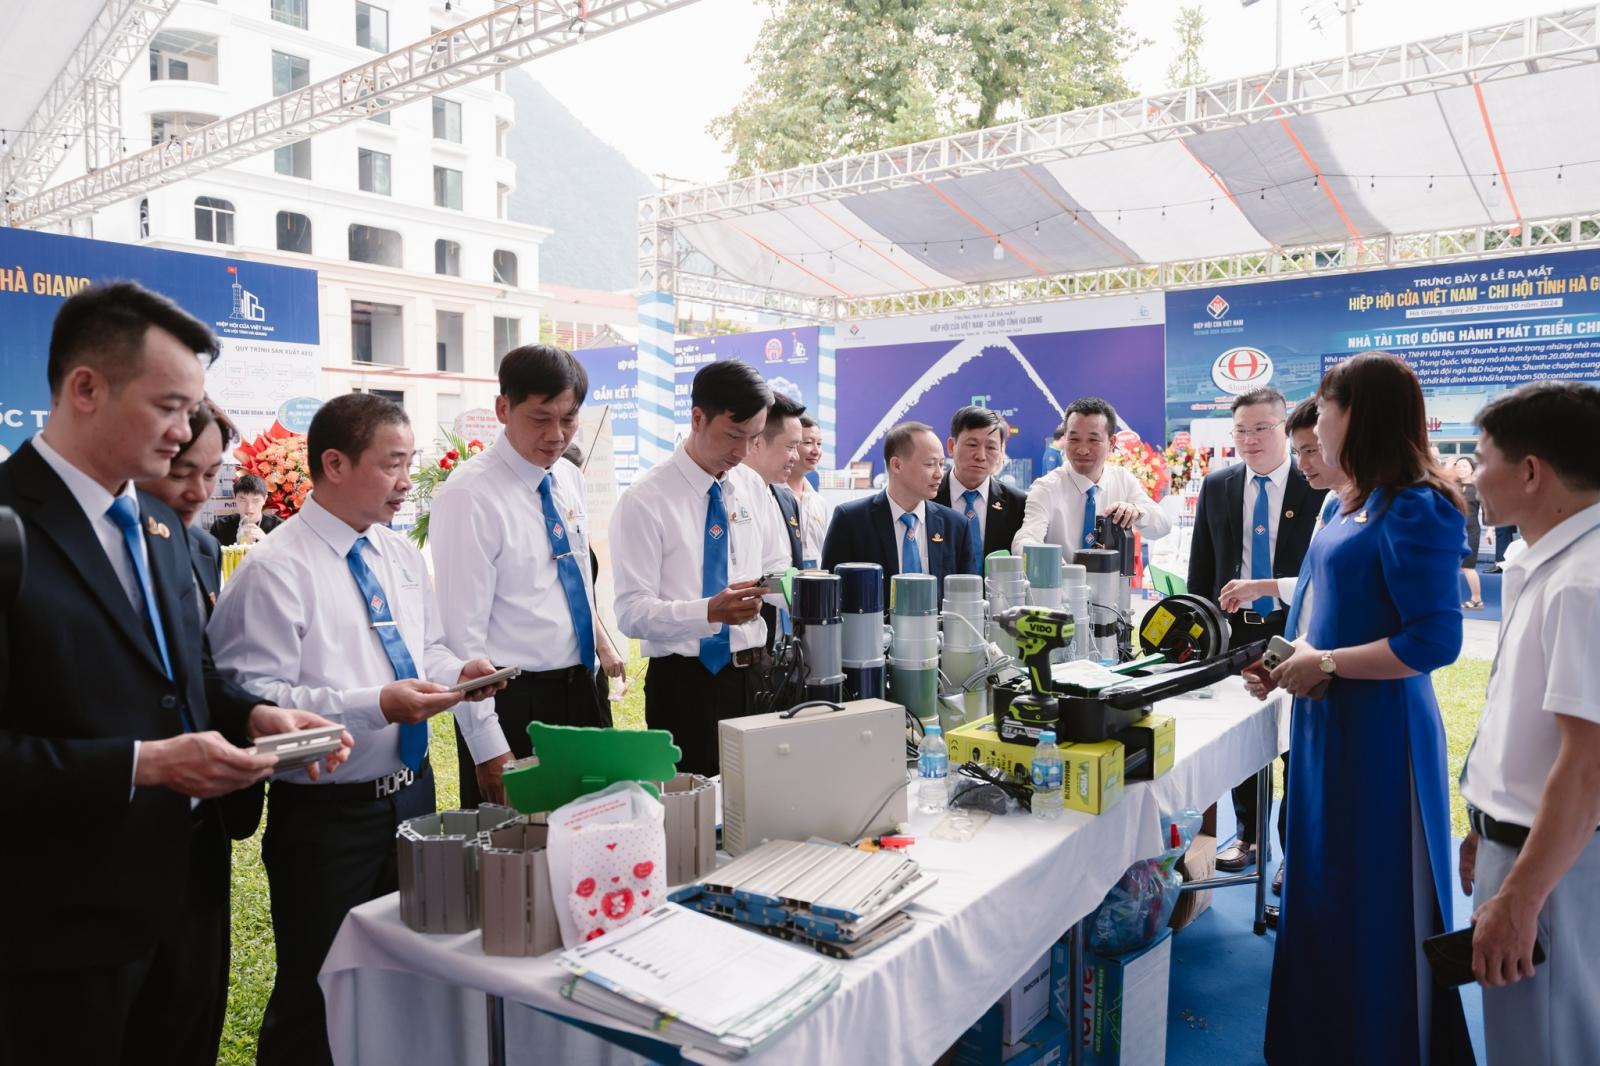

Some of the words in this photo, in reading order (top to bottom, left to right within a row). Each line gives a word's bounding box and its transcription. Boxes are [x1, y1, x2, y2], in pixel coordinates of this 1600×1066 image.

[0, 266, 28, 293] HÀ
[1413, 277, 1452, 288] TRƯNG
[1454, 273, 1477, 285] BÀY
[1491, 267, 1504, 280] LỄ
[1507, 269, 1524, 279] RA
[1526, 264, 1554, 277] MẮT
[1349, 294, 1374, 312] HIỆP
[1376, 292, 1394, 310] HỘI
[1397, 288, 1419, 307] CỬA
[1422, 287, 1448, 306] VIỆT
[1450, 286, 1478, 301] NAM
[1489, 284, 1509, 299] CHI
[1512, 281, 1532, 298] HỘI
[1536, 276, 1566, 295] TỈNH
[1569, 274, 1587, 292] HÀ
[1348, 334, 1372, 348] NHÀ
[1374, 333, 1392, 346] TÀI
[1396, 331, 1418, 347] TRỢ
[1422, 328, 1455, 344] ĐỒNG
[1459, 327, 1493, 341] HÀNH
[1497, 324, 1530, 338] PHÁT
[1534, 318, 1572, 336] TRIỂN
[1471, 346, 1498, 355] Shunhe
[1522, 363, 1550, 371] Shunhe
[30, 410, 51, 428] T
[1030, 623, 1052, 634] VIDO
[1080, 774, 1088, 796] VIDO
